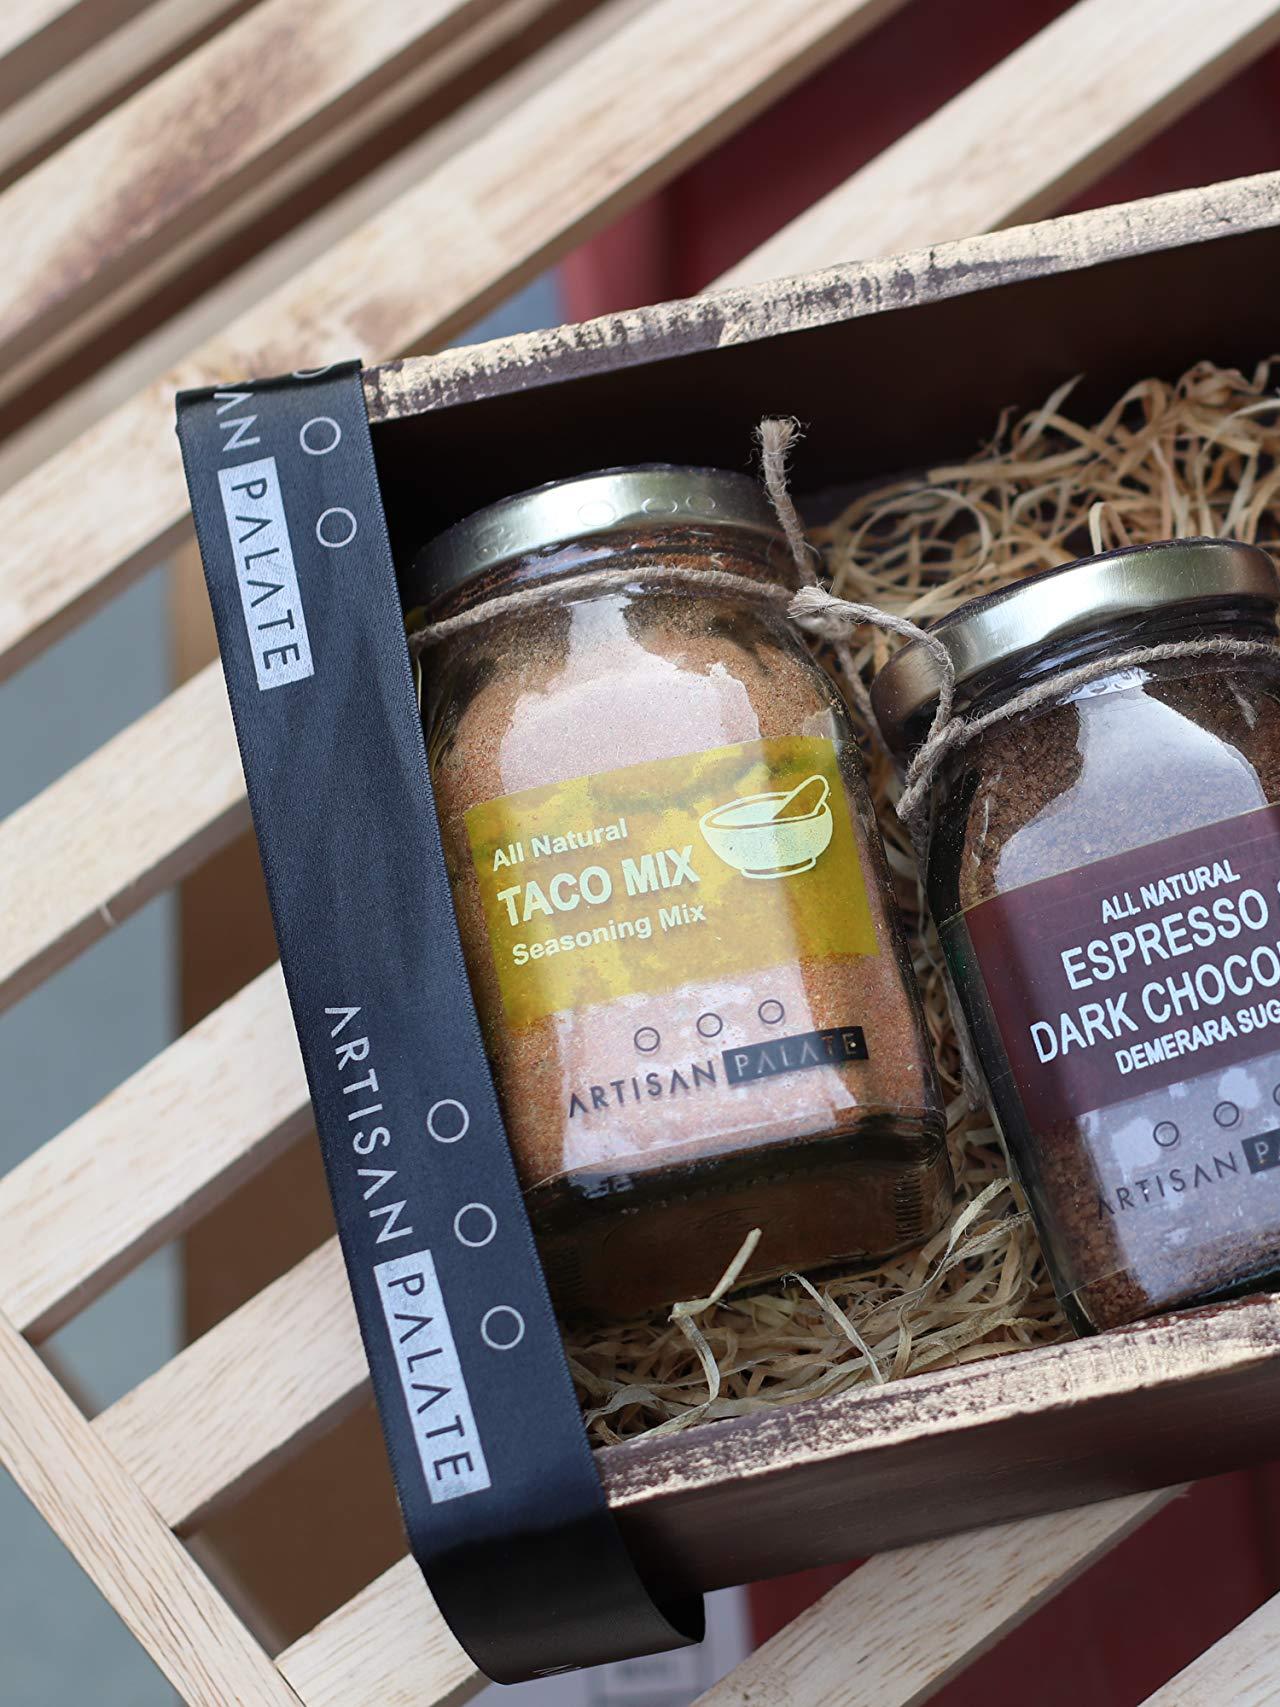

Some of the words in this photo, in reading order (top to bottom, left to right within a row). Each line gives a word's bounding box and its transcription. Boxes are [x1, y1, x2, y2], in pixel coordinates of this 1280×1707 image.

[230, 477, 301, 670] PALATE
[493, 845, 525, 872] All
[532, 818, 628, 860] Natural
[497, 865, 612, 926] TACO
[622, 845, 700, 896] MIX
[1102, 895, 1141, 924] ALL
[1140, 859, 1240, 908] NATURAL
[512, 917, 652, 966] Seasoning
[658, 903, 707, 933] Mix
[1060, 889, 1269, 990] ESPRESSO
[1029, 992, 1138, 1063] DARK
[1115, 1016, 1238, 1074] DEMERARA
[568, 1061, 717, 1118] ARTISAN
[734, 1032, 858, 1077] PALATE
[1099, 1150, 1239, 1219] ARTISAN
[325, 1006, 413, 1244] ARTISAN
[387, 1272, 475, 1480] PALATE
